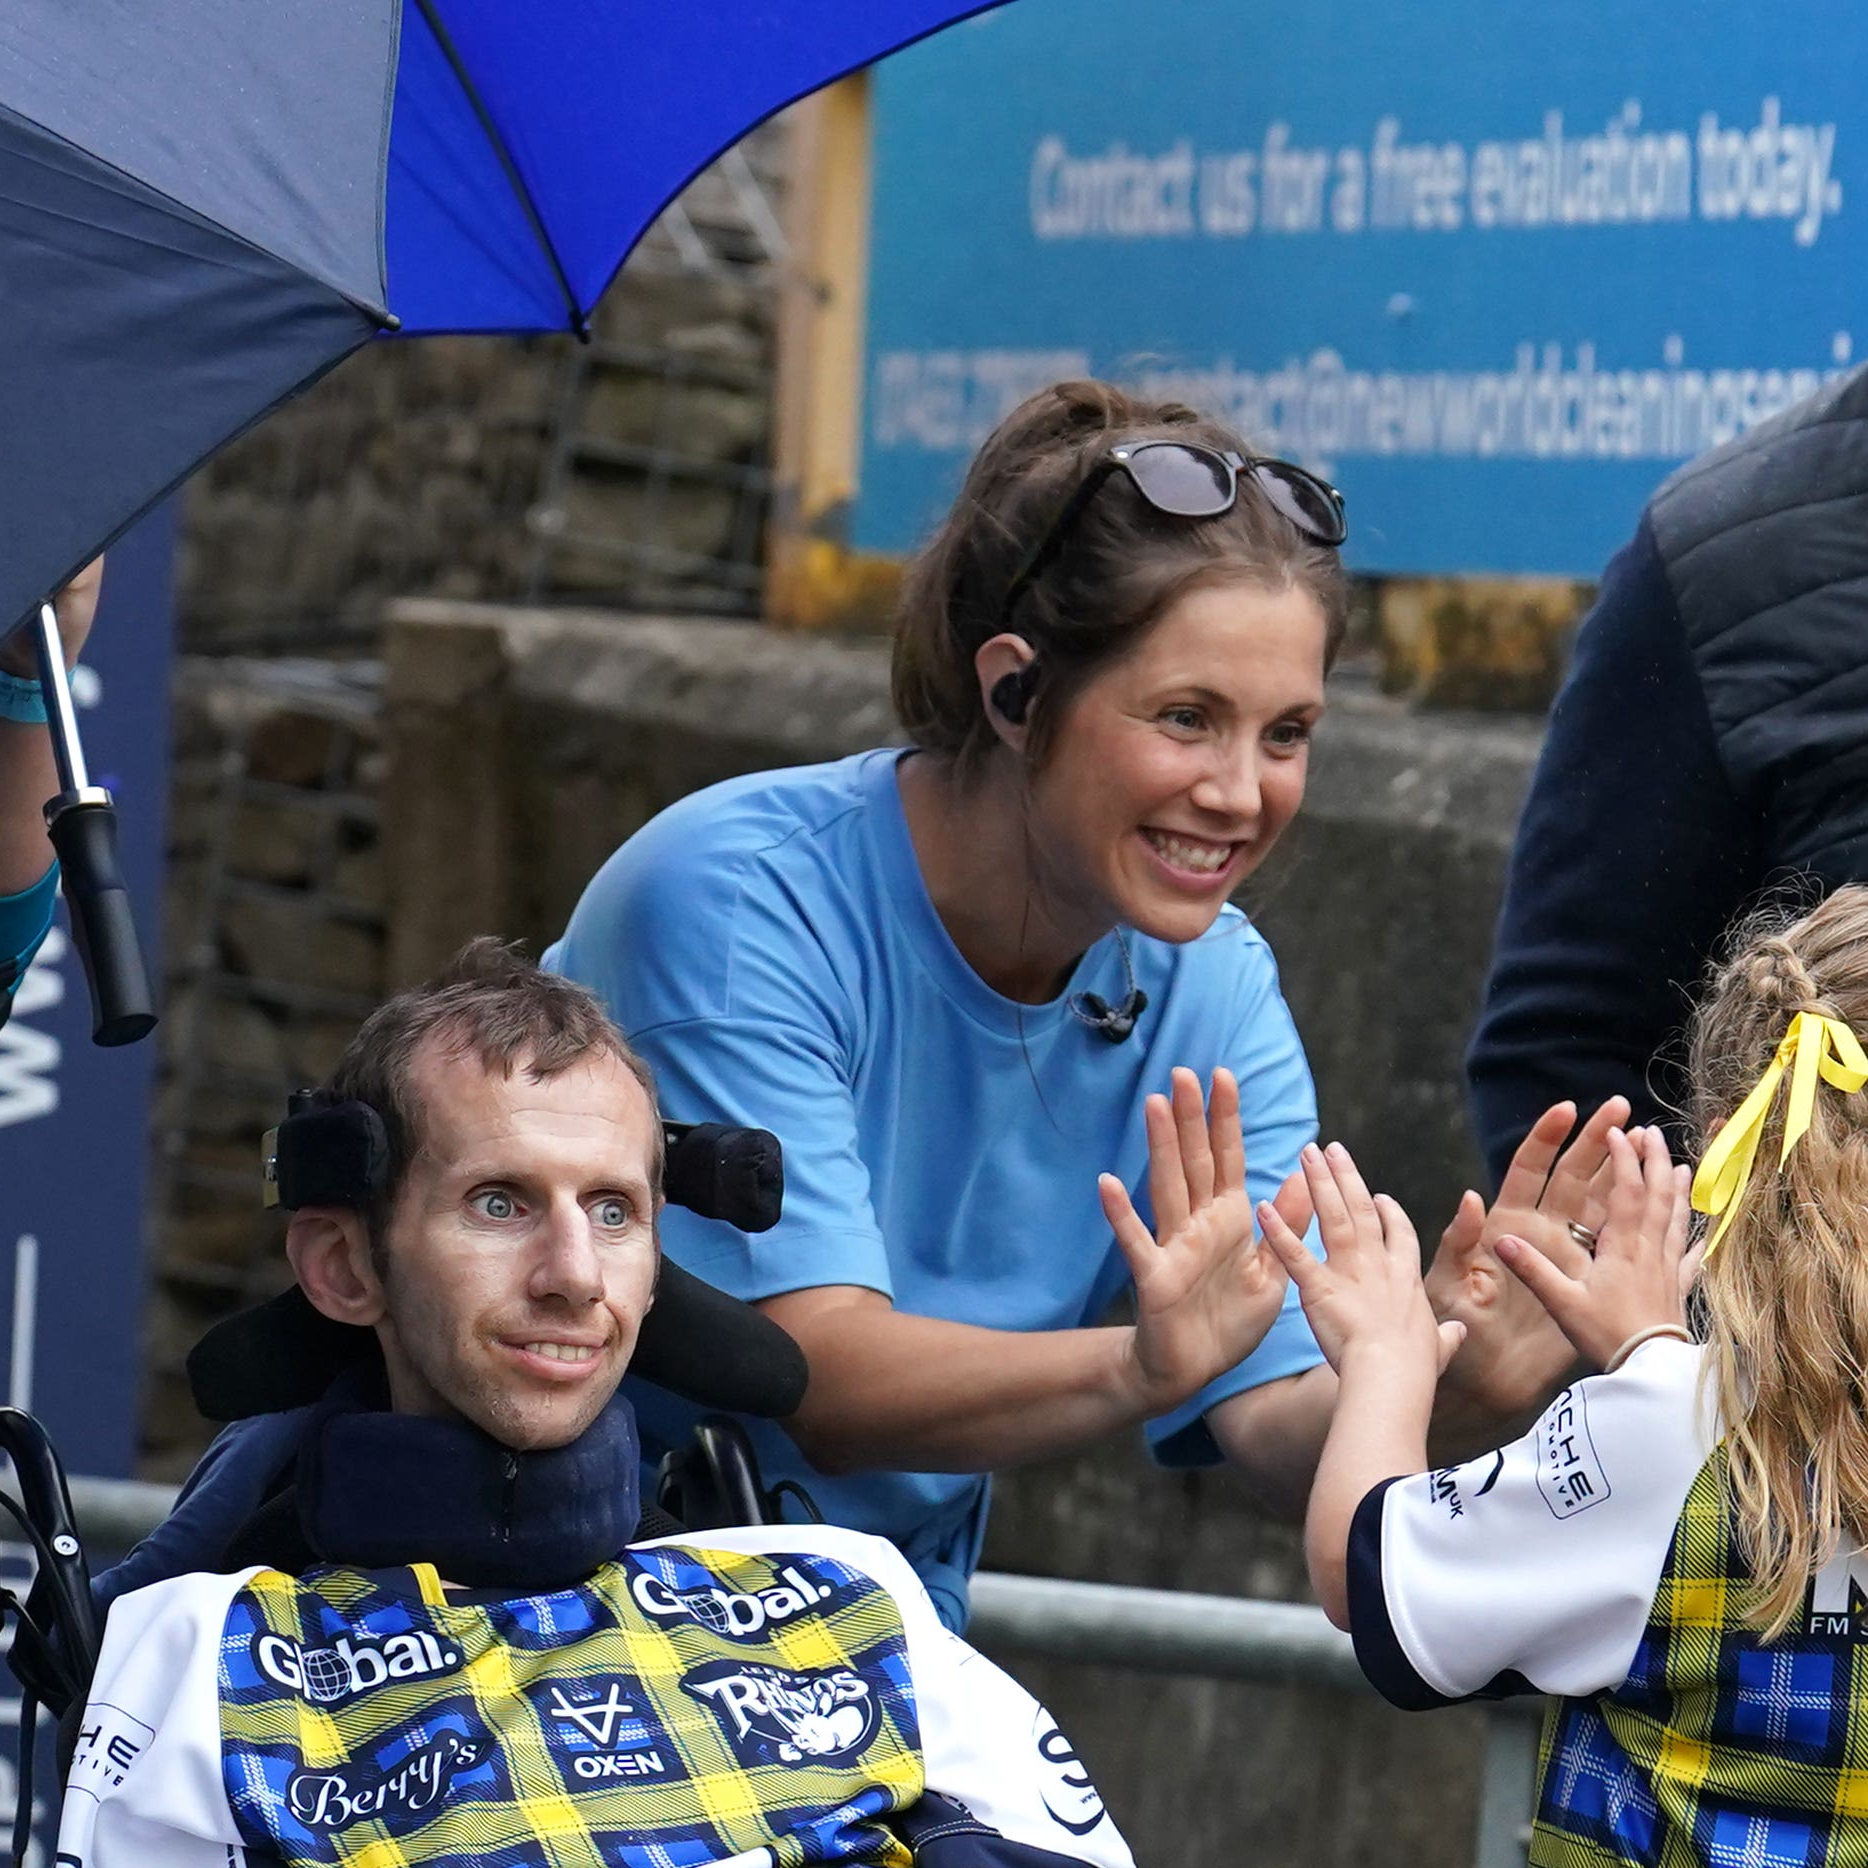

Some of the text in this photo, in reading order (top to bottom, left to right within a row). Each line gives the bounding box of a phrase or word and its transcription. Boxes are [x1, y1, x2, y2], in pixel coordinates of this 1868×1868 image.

[1030, 93, 1842, 248] Contact us for a free evaluation today.
[1809, 1616, 1849, 1636] FM
[290, 1738, 478, 1826] Berry's
[574, 1751, 665, 1778] OXEN
